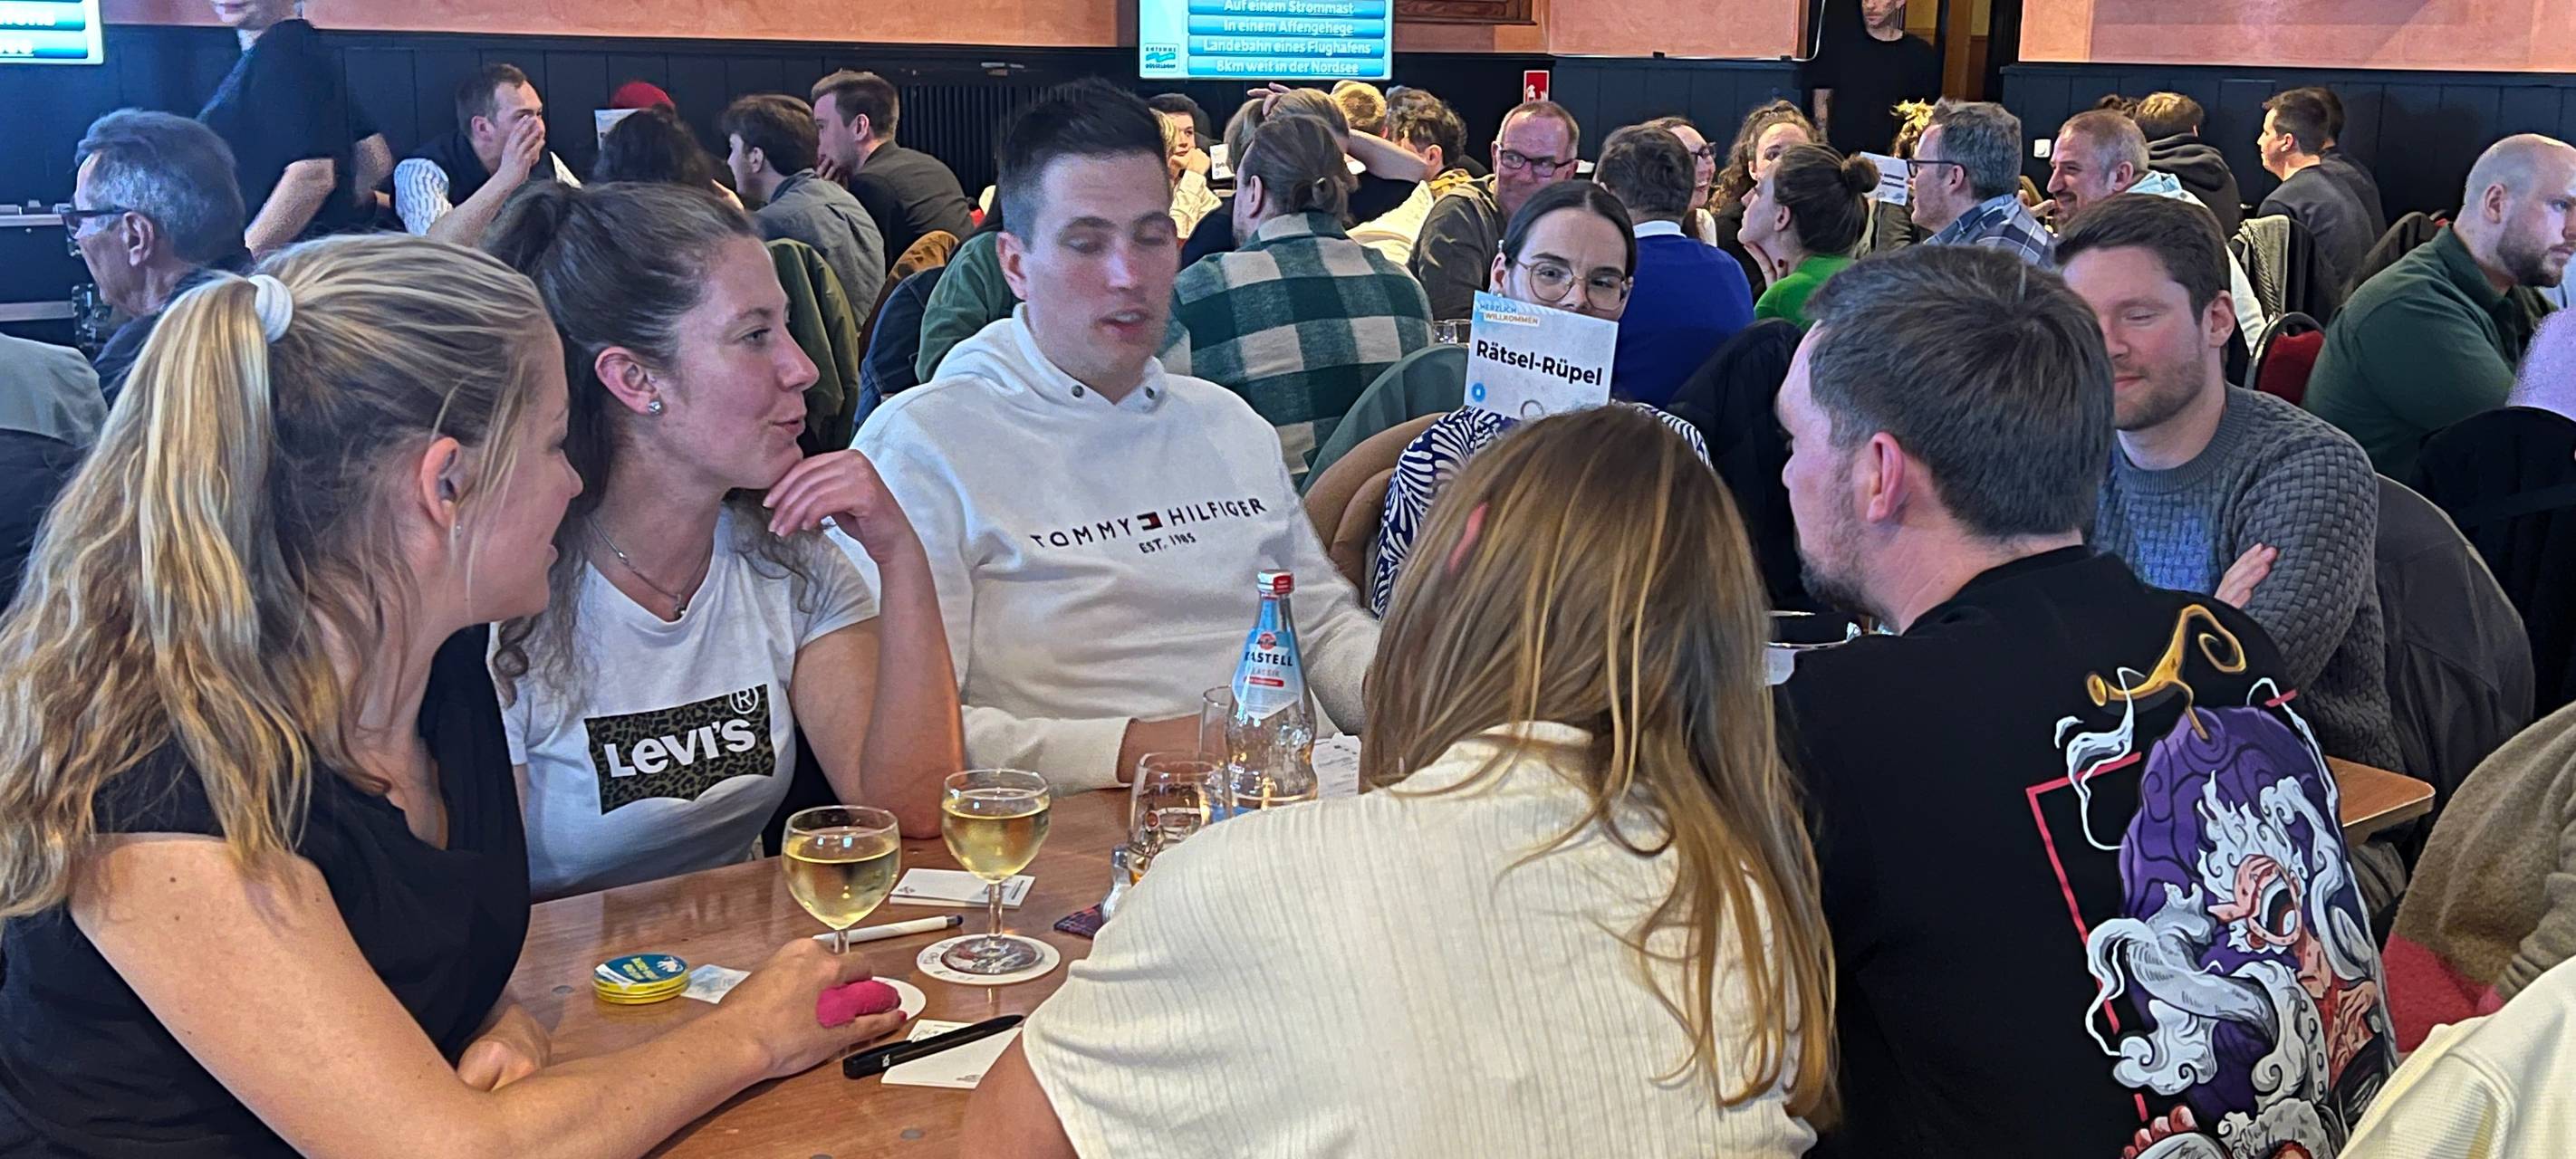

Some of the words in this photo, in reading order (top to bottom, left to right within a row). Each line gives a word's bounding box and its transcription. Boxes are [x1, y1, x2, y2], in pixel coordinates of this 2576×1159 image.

[1224, 0, 1247, 11] Auf
[1248, 1, 1286, 12] einem
[1288, 1, 1355, 14] Strommast
[1224, 19, 1236, 32] In
[1238, 20, 1276, 33] einem
[1278, 21, 1354, 36] Affengehege
[1203, 39, 1272, 53] Landebahn
[1274, 42, 1305, 53] eines
[1307, 41, 1371, 56] Flughafens
[1216, 60, 1244, 72] 8km
[1245, 60, 1274, 72] weit
[1274, 61, 1287, 72] in
[1288, 61, 1310, 73] der
[1311, 61, 1359, 73] Nordsee
[1480, 303, 1516, 313] HERZLICH
[1485, 313, 1538, 324] WILLKOMMEN
[1476, 340, 1602, 386] Rätsel-Rüpel
[1030, 517, 1132, 548] TOMMY
[1168, 497, 1268, 527] HILFIGER
[1139, 538, 1168, 553] EST.
